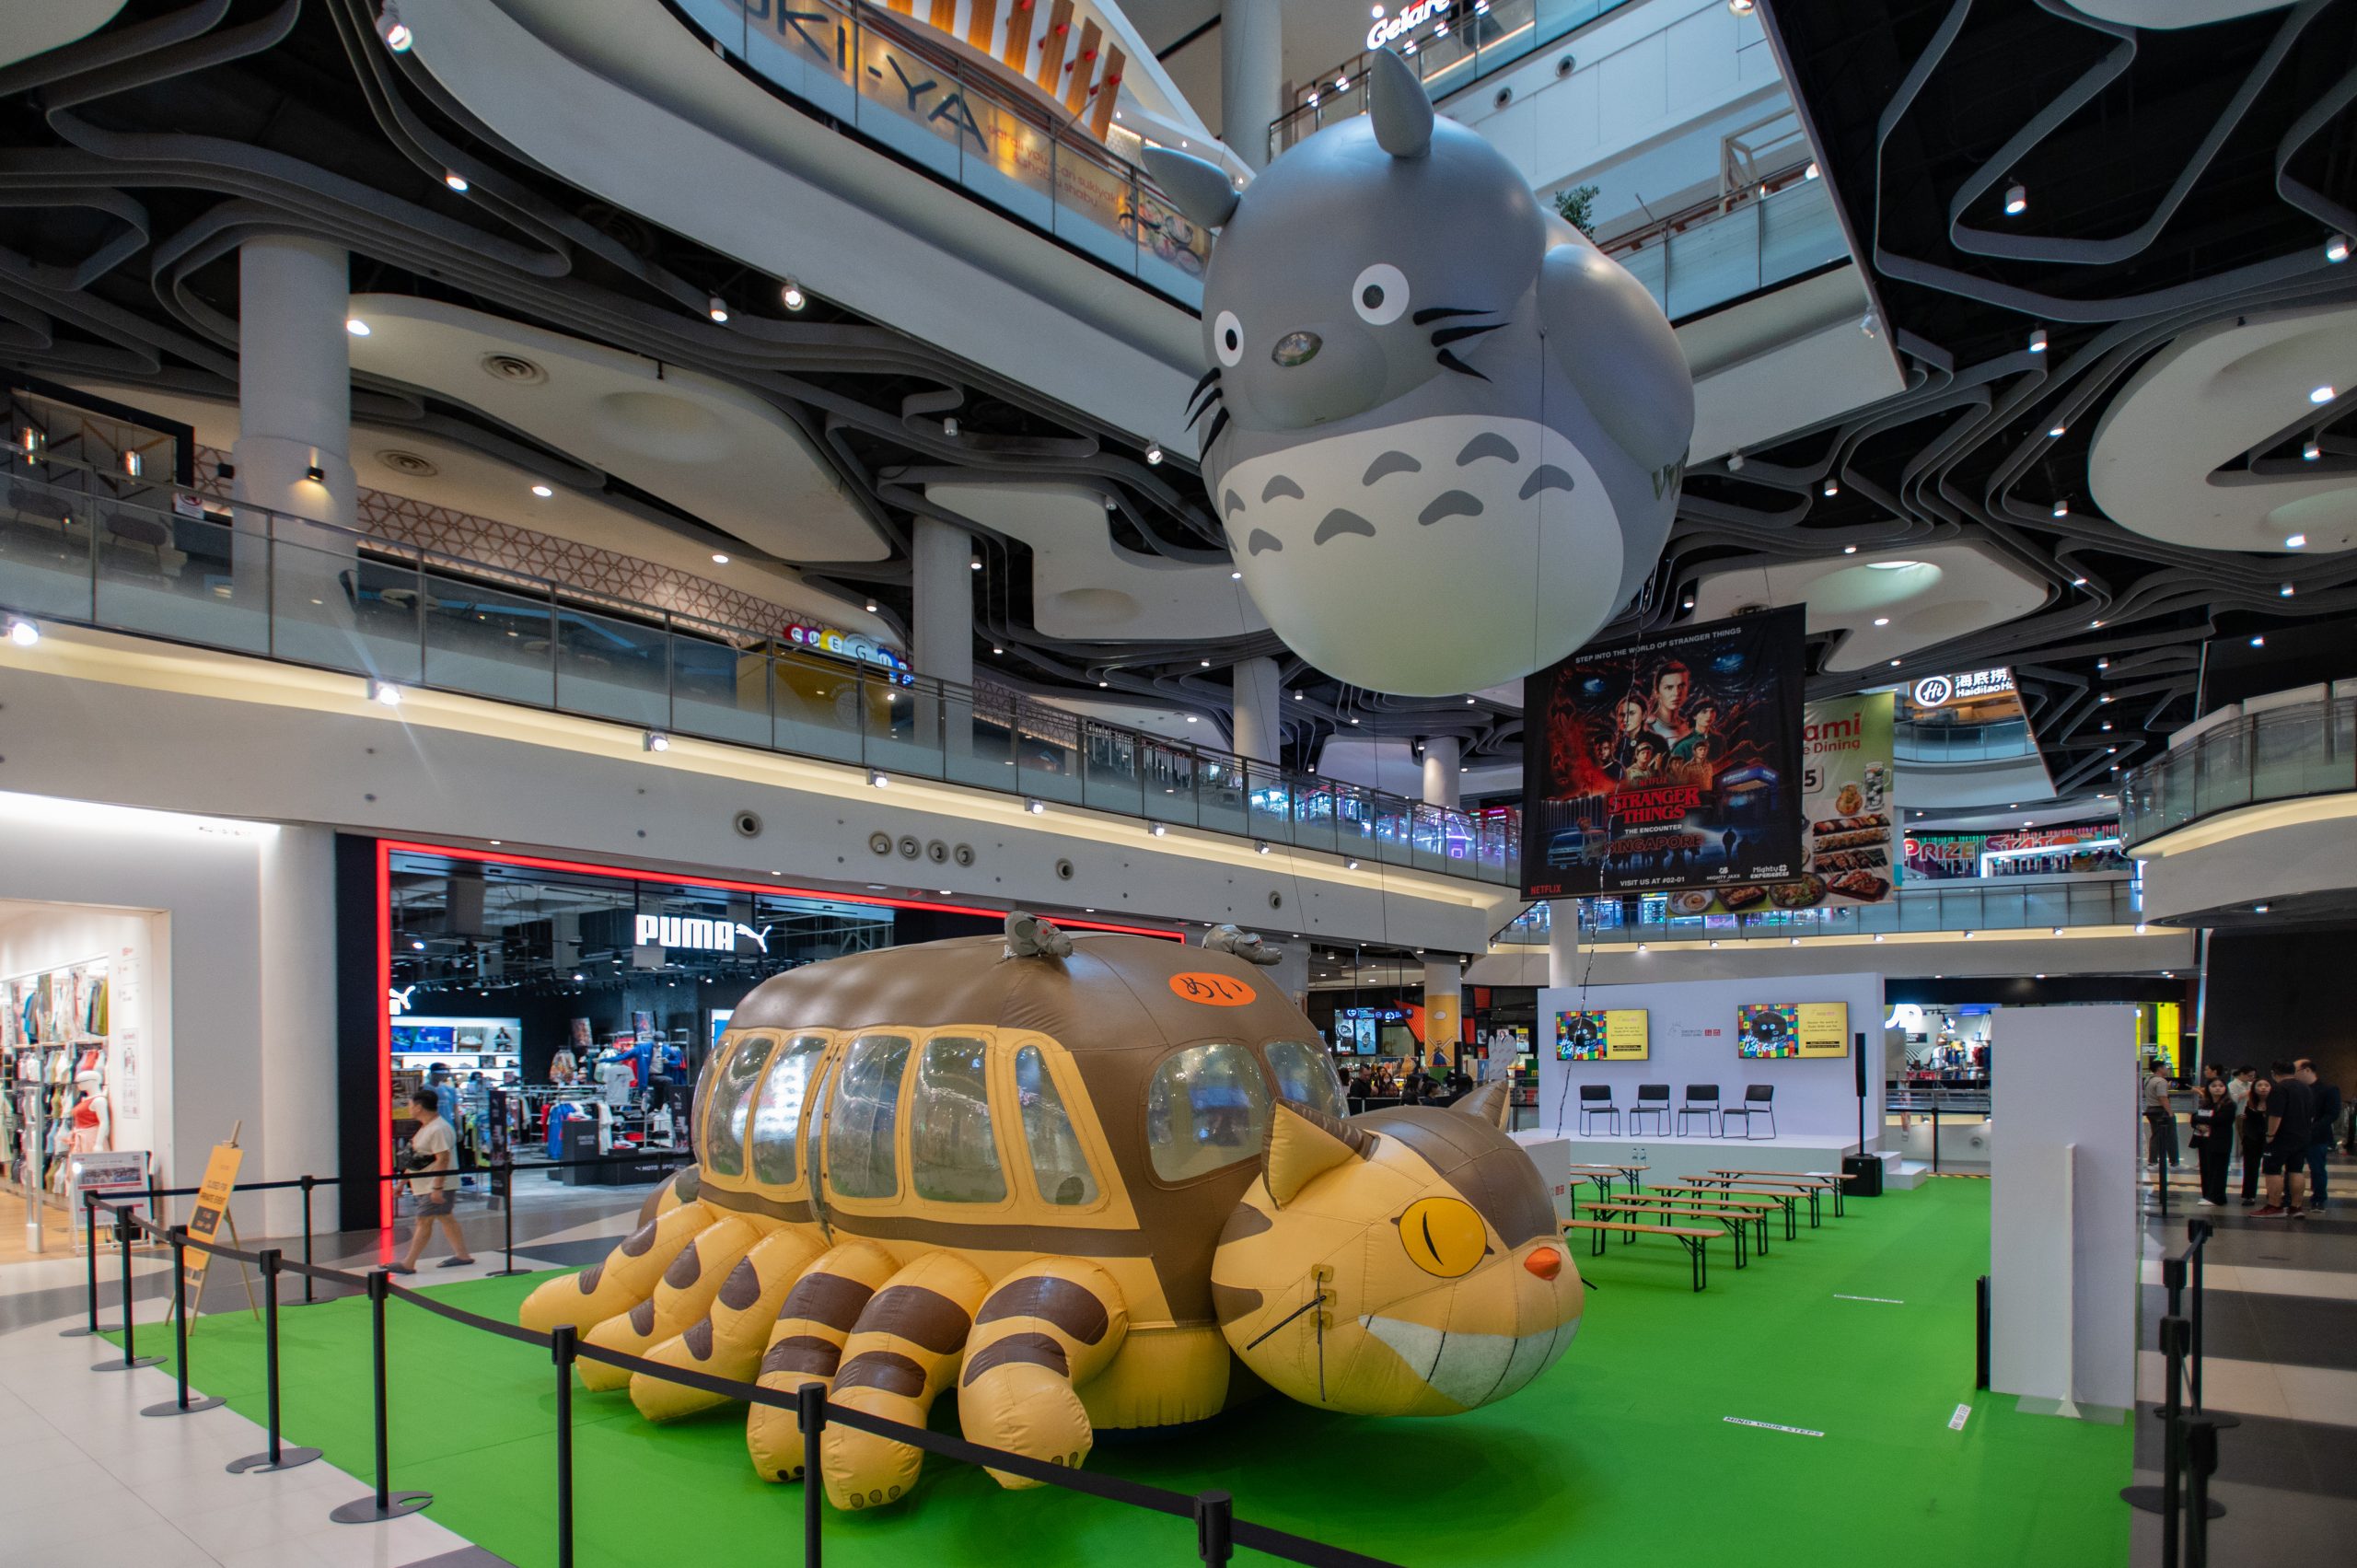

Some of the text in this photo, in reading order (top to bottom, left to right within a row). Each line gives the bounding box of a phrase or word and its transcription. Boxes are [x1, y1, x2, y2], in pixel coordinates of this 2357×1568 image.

[1027, 146, 1049, 166] you
[1078, 176, 1120, 205] sukiyaki
[1065, 183, 1097, 207] shabu
[1575, 627, 1742, 664] STEP INTO THE WORLD OF STRANGER THINGS
[1956, 668, 2011, 689] 海底捞
[1956, 684, 2000, 698] Haidilao
[1814, 739, 1861, 753] Dining
[1608, 787, 1701, 813] STRANGER
[1624, 805, 1686, 824] THINGS
[1640, 824, 1682, 833] ENCOUNTER
[1605, 833, 1705, 854] SINGAPORE
[1903, 838, 1976, 861] PRIZE
[1753, 865, 1778, 874] Mighty
[1530, 884, 1562, 895] NETFLIX
[636, 914, 735, 951] PUMA
[1757, 1422, 1782, 1430] YOUR
[1787, 1427, 1820, 1435] STEPS
